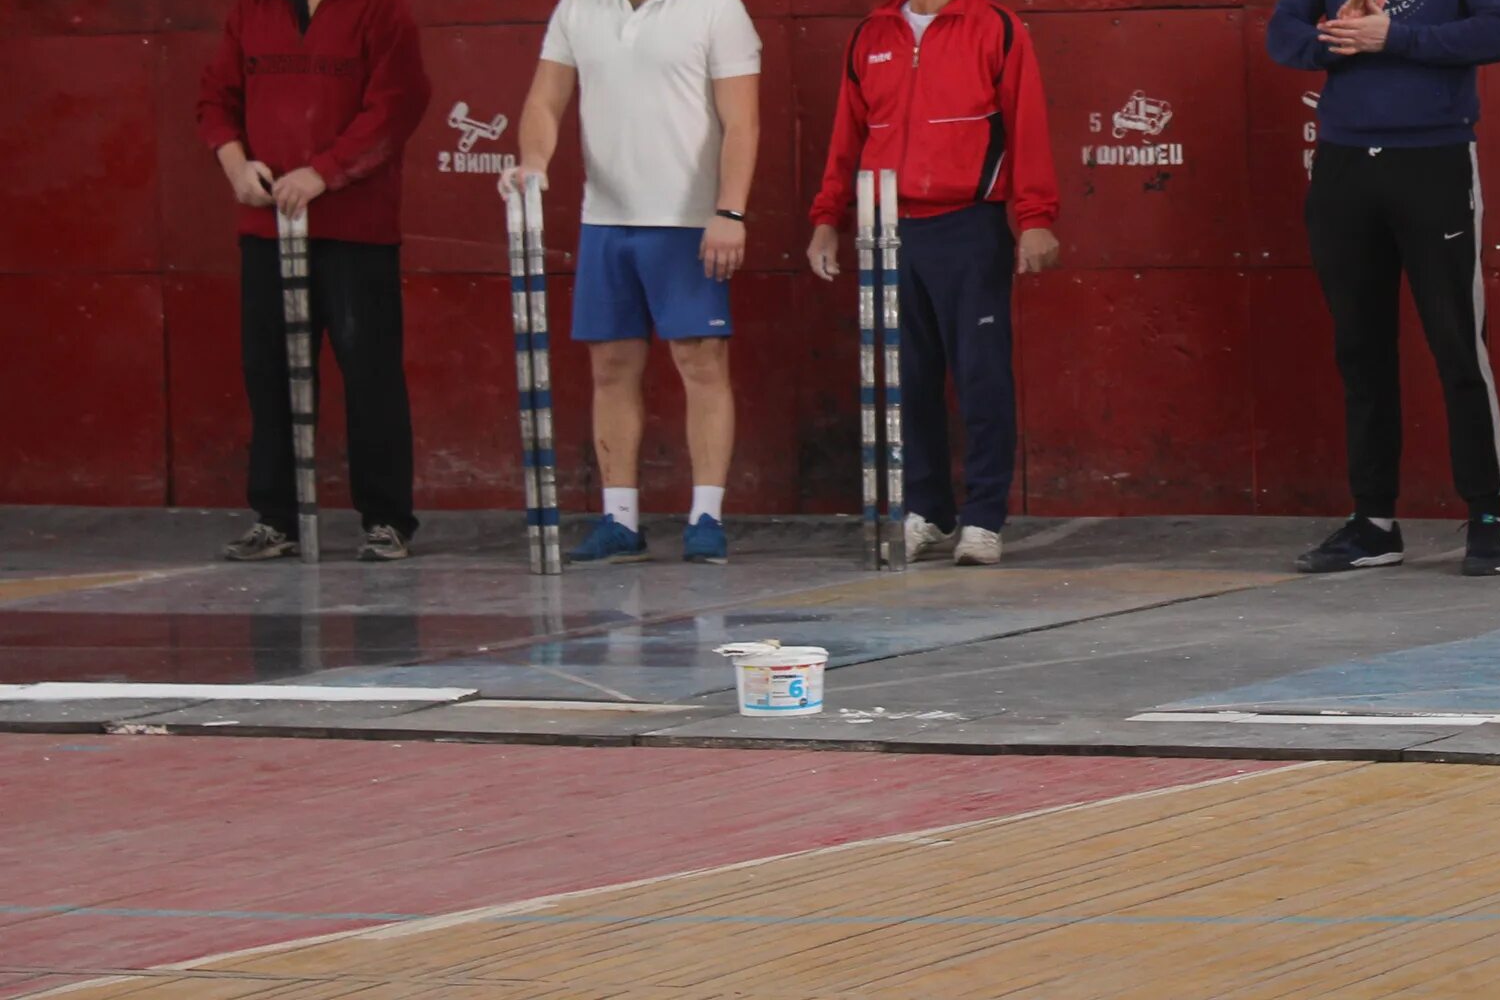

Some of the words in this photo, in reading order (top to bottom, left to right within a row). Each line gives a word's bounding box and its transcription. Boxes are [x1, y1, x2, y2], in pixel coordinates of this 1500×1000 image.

[1089, 113, 1102, 132] 5
[1303, 121, 1316, 142] 6
[438, 151, 451, 172] 2
[789, 679, 804, 698] 6
